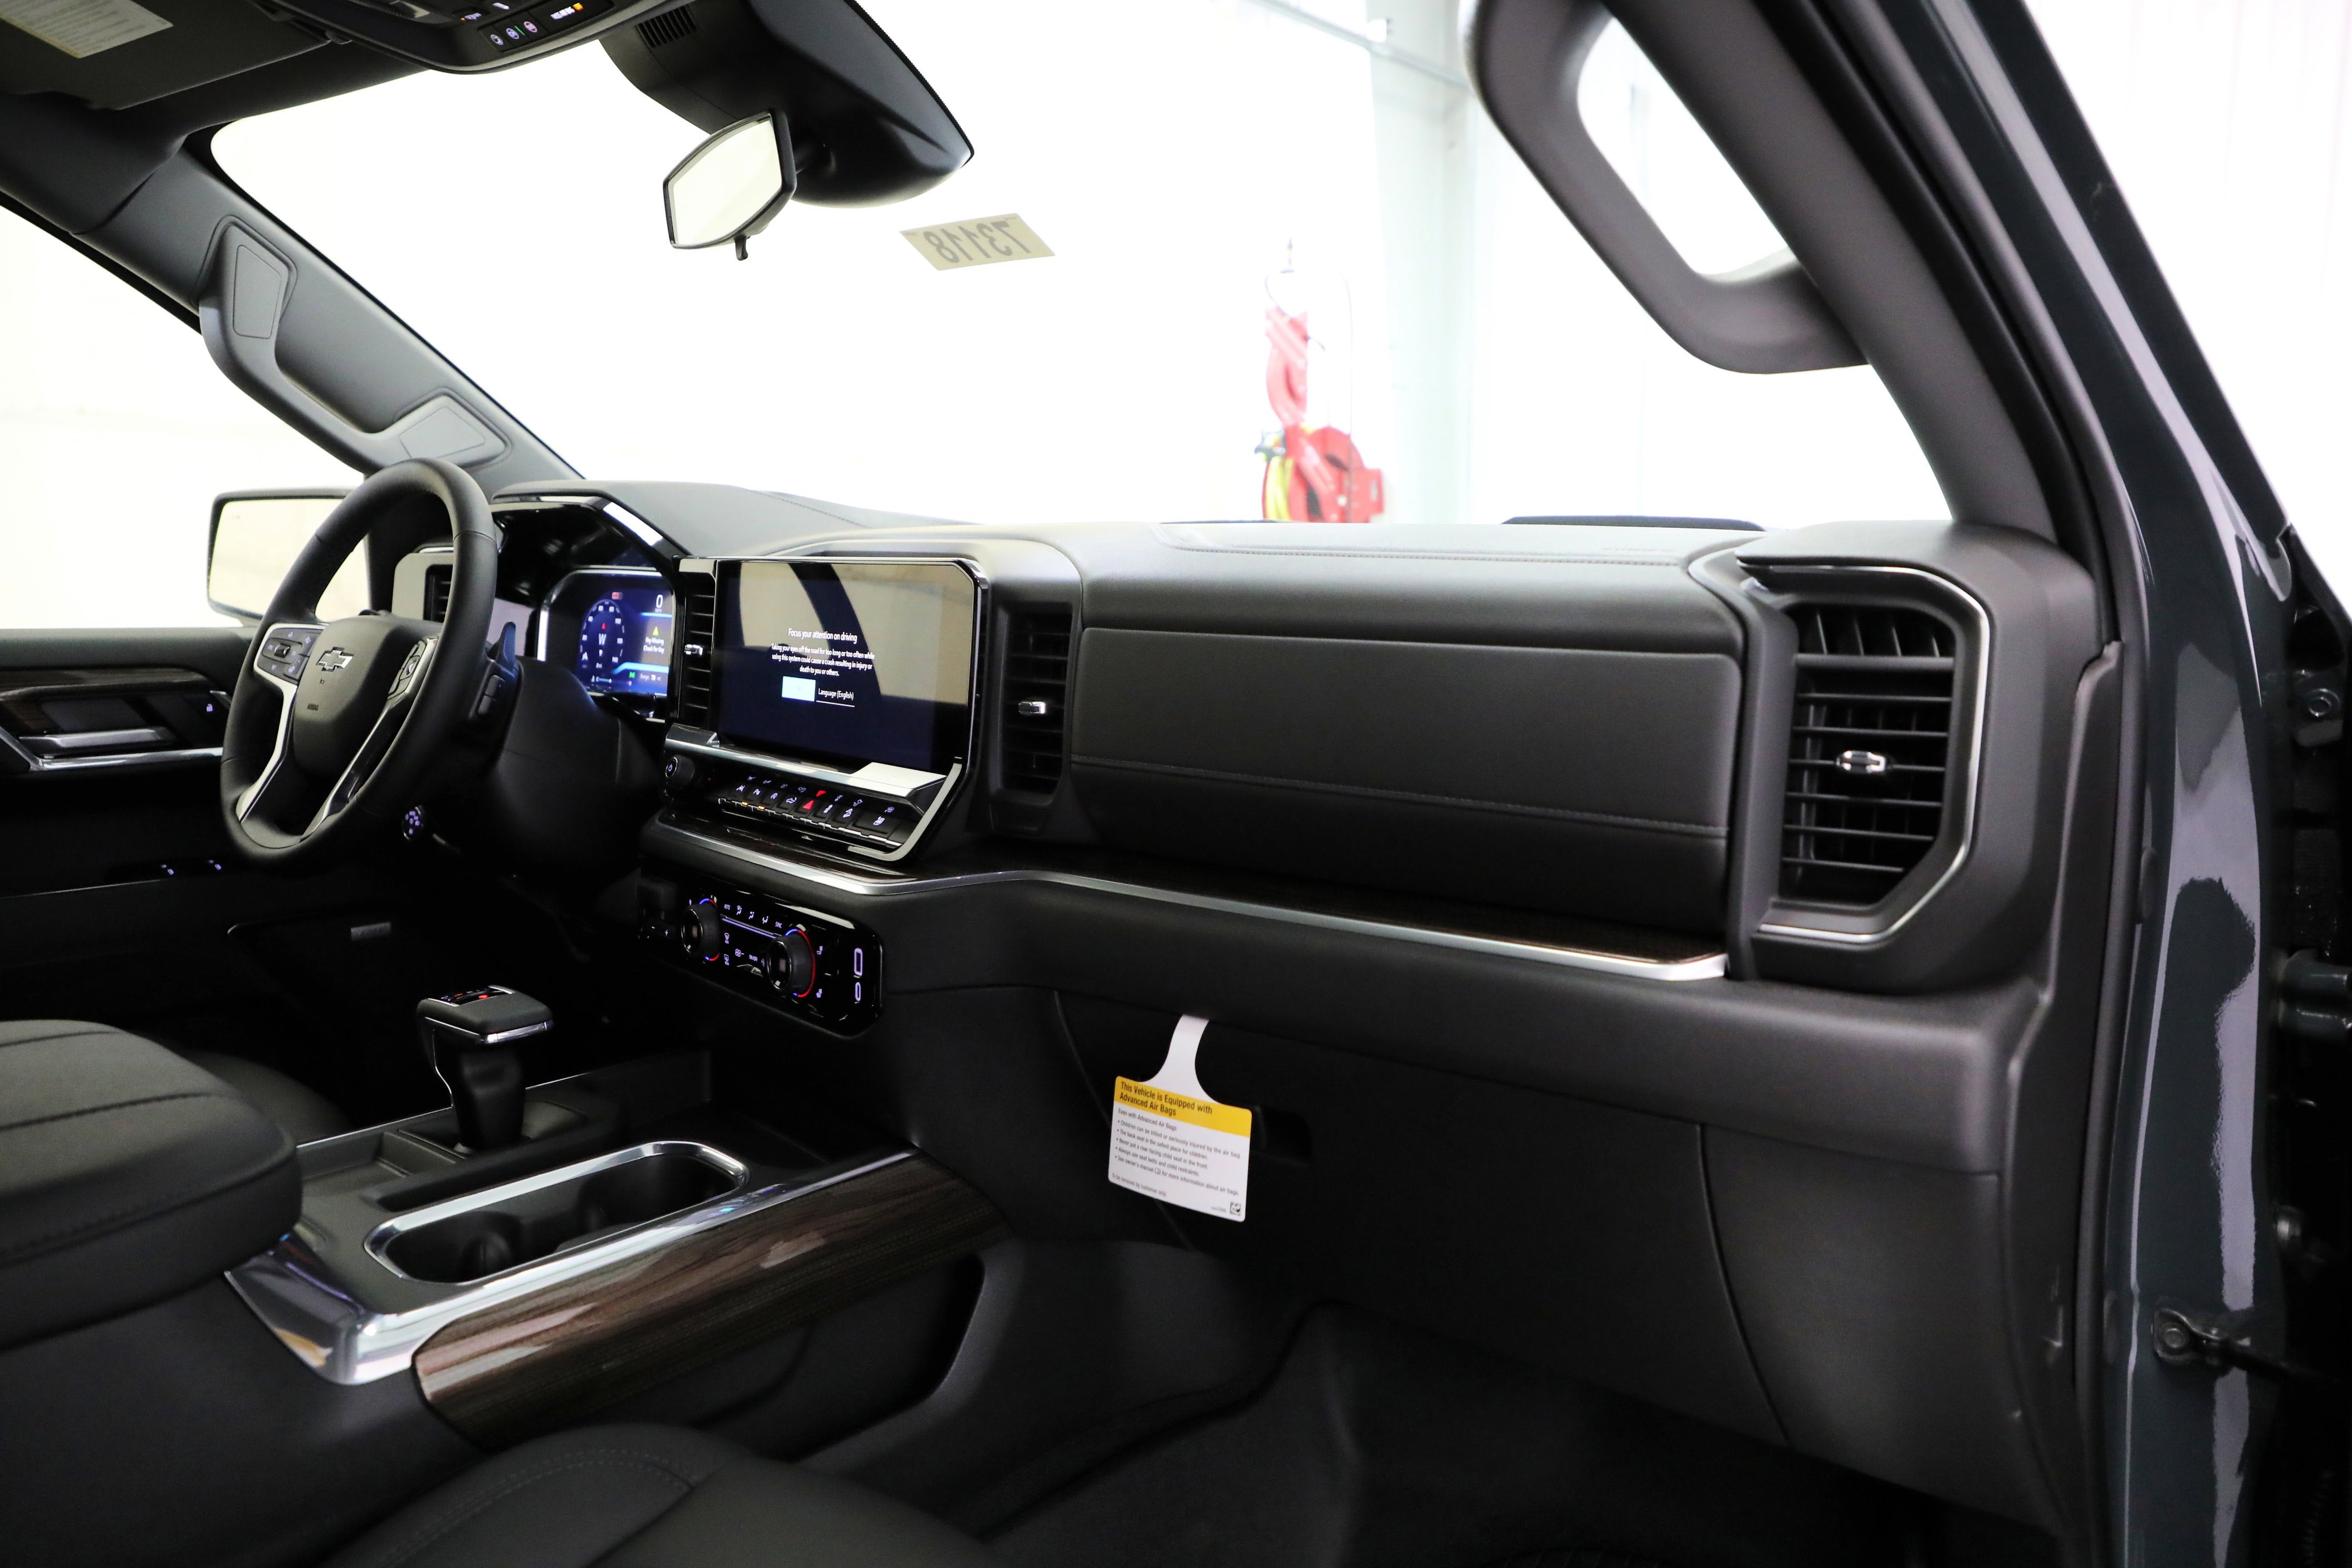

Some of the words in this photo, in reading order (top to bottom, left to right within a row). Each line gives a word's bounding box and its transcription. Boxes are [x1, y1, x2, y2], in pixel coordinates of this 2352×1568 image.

[788, 628, 801, 637] Focus
[812, 631, 834, 640] attention
[841, 632, 857, 644] driving
[771, 643, 782, 652] Taking
[832, 649, 841, 658] long
[835, 660, 851, 669] resulting
[856, 662, 867, 671] injury
[818, 688, 837, 698] Language
[837, 690, 854, 701] (English)
[1120, 1092, 1148, 1108] Advanced
[1160, 1104, 1176, 1116] Bags
[1121, 1082, 1132, 1092] This
[1134, 1086, 1155, 1099] Vehicle
[1157, 1093, 1162, 1101] is
[1164, 1094, 1195, 1110] Equipped
[1197, 1104, 1212, 1114] with
[1138, 1114, 1158, 1125] Advanced
[1121, 1120, 1136, 1130] Children
[1169, 1136, 1188, 1145] seriously
[1189, 1141, 1206, 1150] injured
[1119, 1147, 1131, 1156] Always
[1121, 1177, 1135, 1185] removed
[1141, 1184, 1158, 1193] customer
[1180, 1176, 1205, 1187] information
